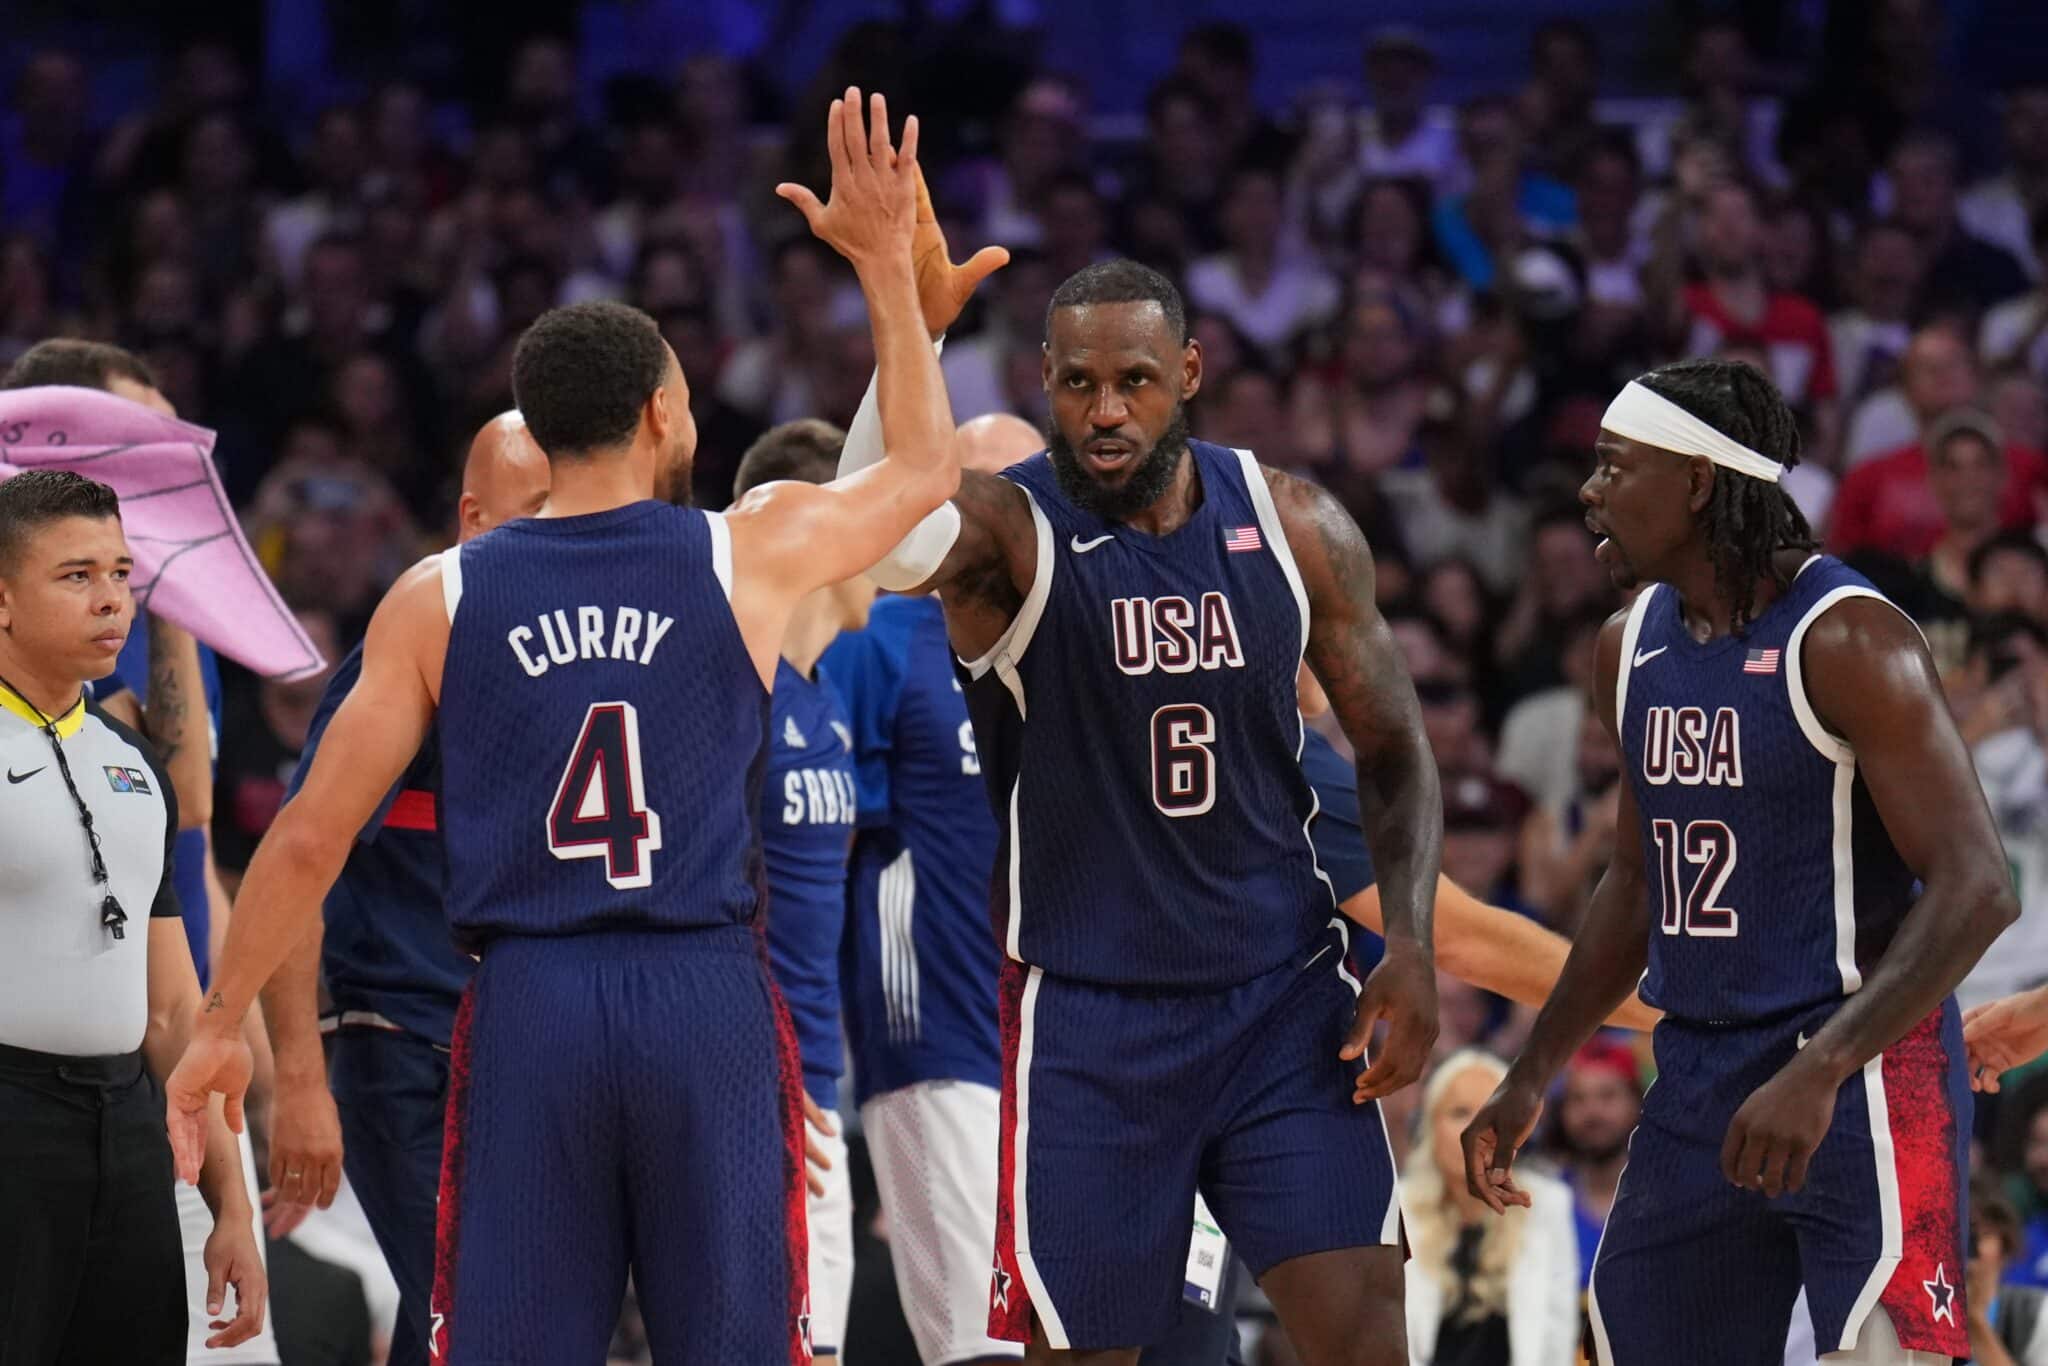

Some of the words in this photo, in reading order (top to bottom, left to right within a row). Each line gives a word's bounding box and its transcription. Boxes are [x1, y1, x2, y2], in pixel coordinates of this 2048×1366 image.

[508, 606, 674, 677] CURRY
[1111, 591, 1245, 675] USA
[546, 701, 662, 890] 4
[1151, 703, 1216, 817] 6
[1644, 707, 1743, 787] USA
[1652, 818, 1738, 937] 12
